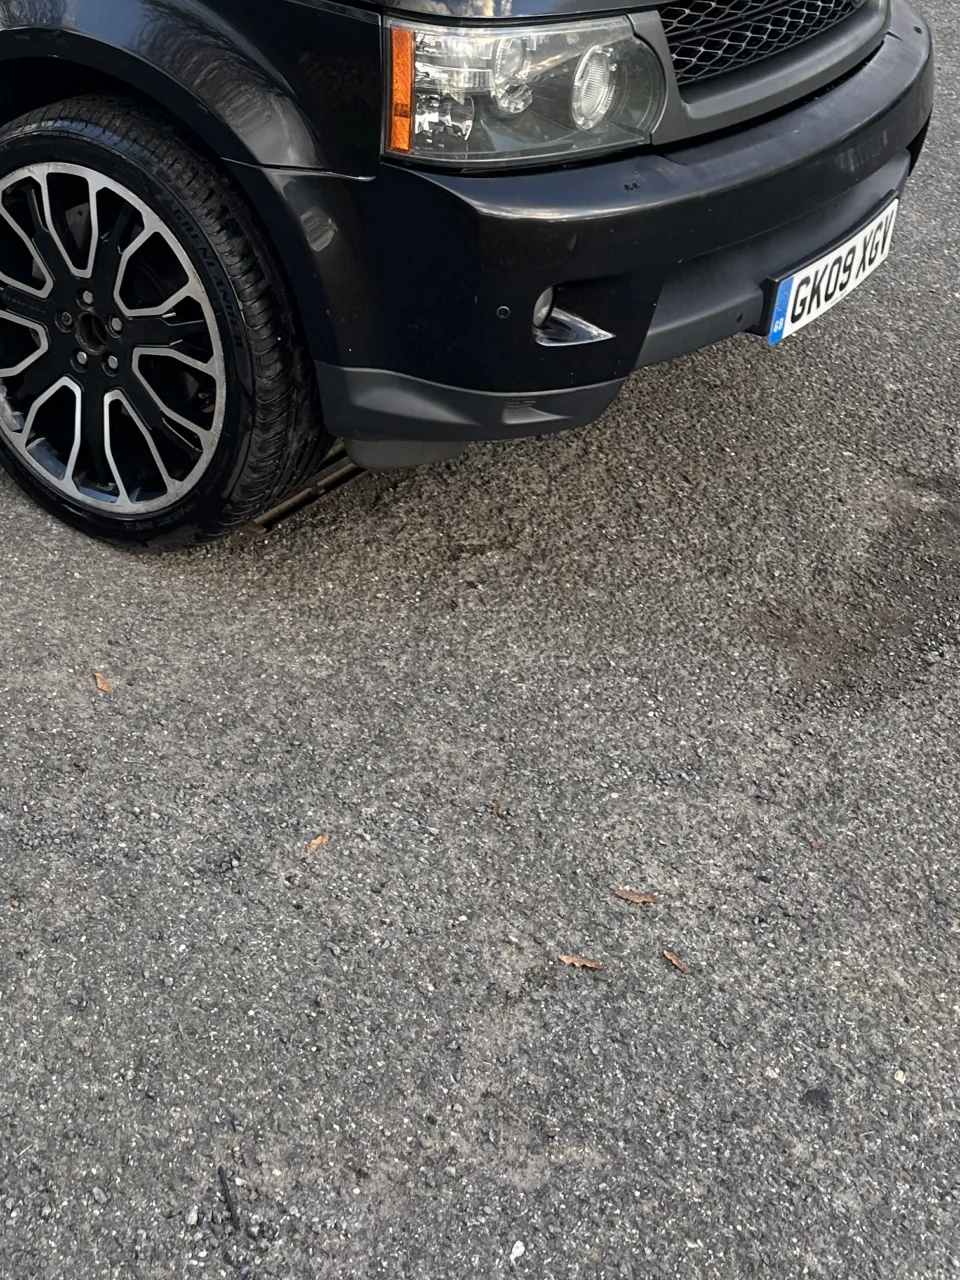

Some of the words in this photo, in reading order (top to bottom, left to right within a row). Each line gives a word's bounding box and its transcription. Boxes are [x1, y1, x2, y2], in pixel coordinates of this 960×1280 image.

[791, 245, 856, 324] GK09
[855, 209, 895, 279] XGV
[773, 317, 784, 333] GB
